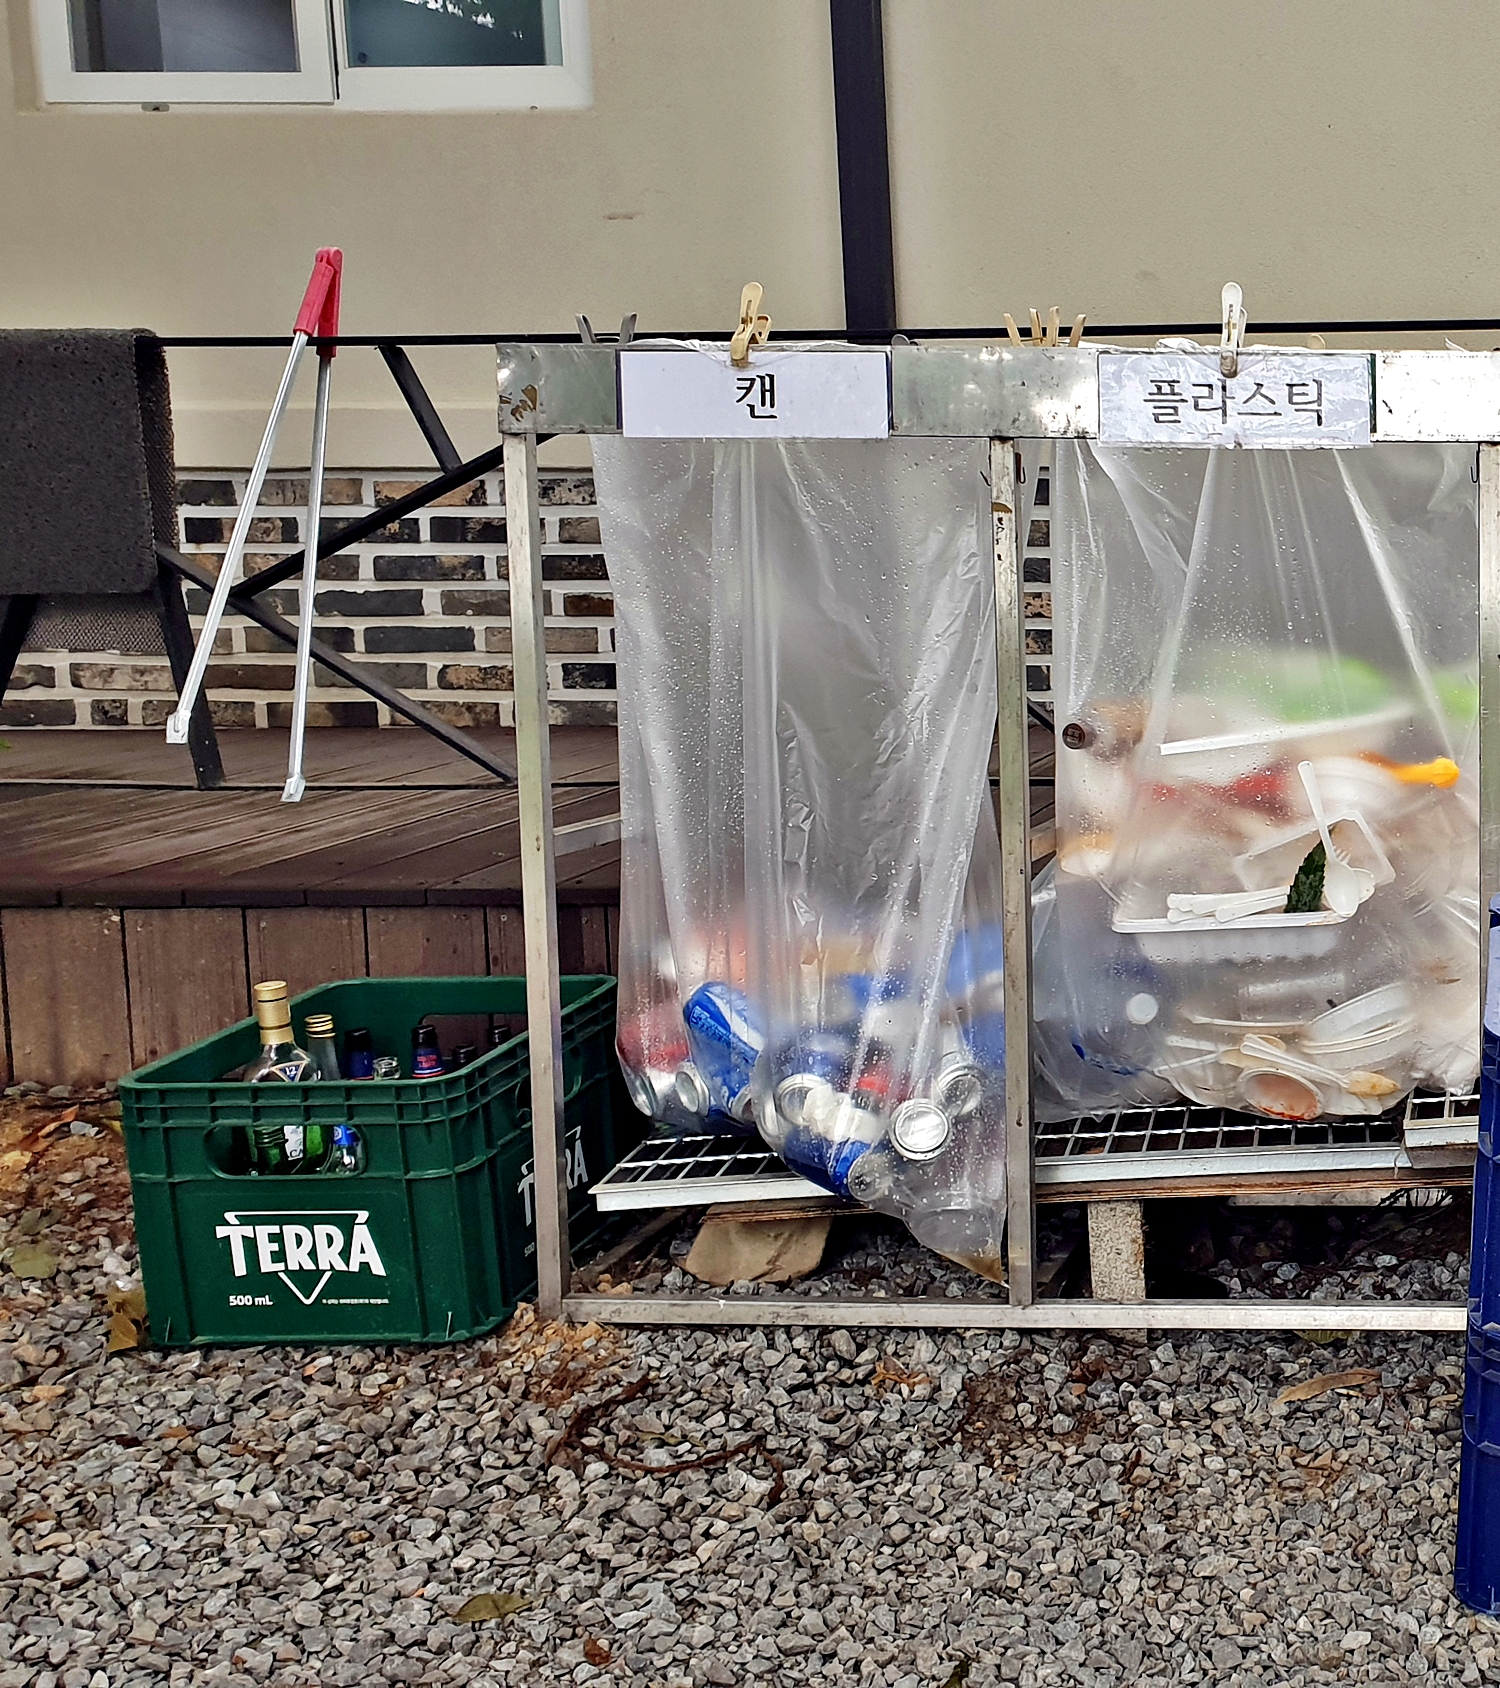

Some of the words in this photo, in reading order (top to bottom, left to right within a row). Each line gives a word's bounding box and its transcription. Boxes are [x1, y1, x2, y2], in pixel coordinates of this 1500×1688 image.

[736, 372, 778, 420] 캔
[1144, 377, 1325, 423] 플라스틱
[285, 1067, 297, 1075] 12
[215, 1224, 387, 1277] TERRA
[229, 1295, 252, 1306] 500
